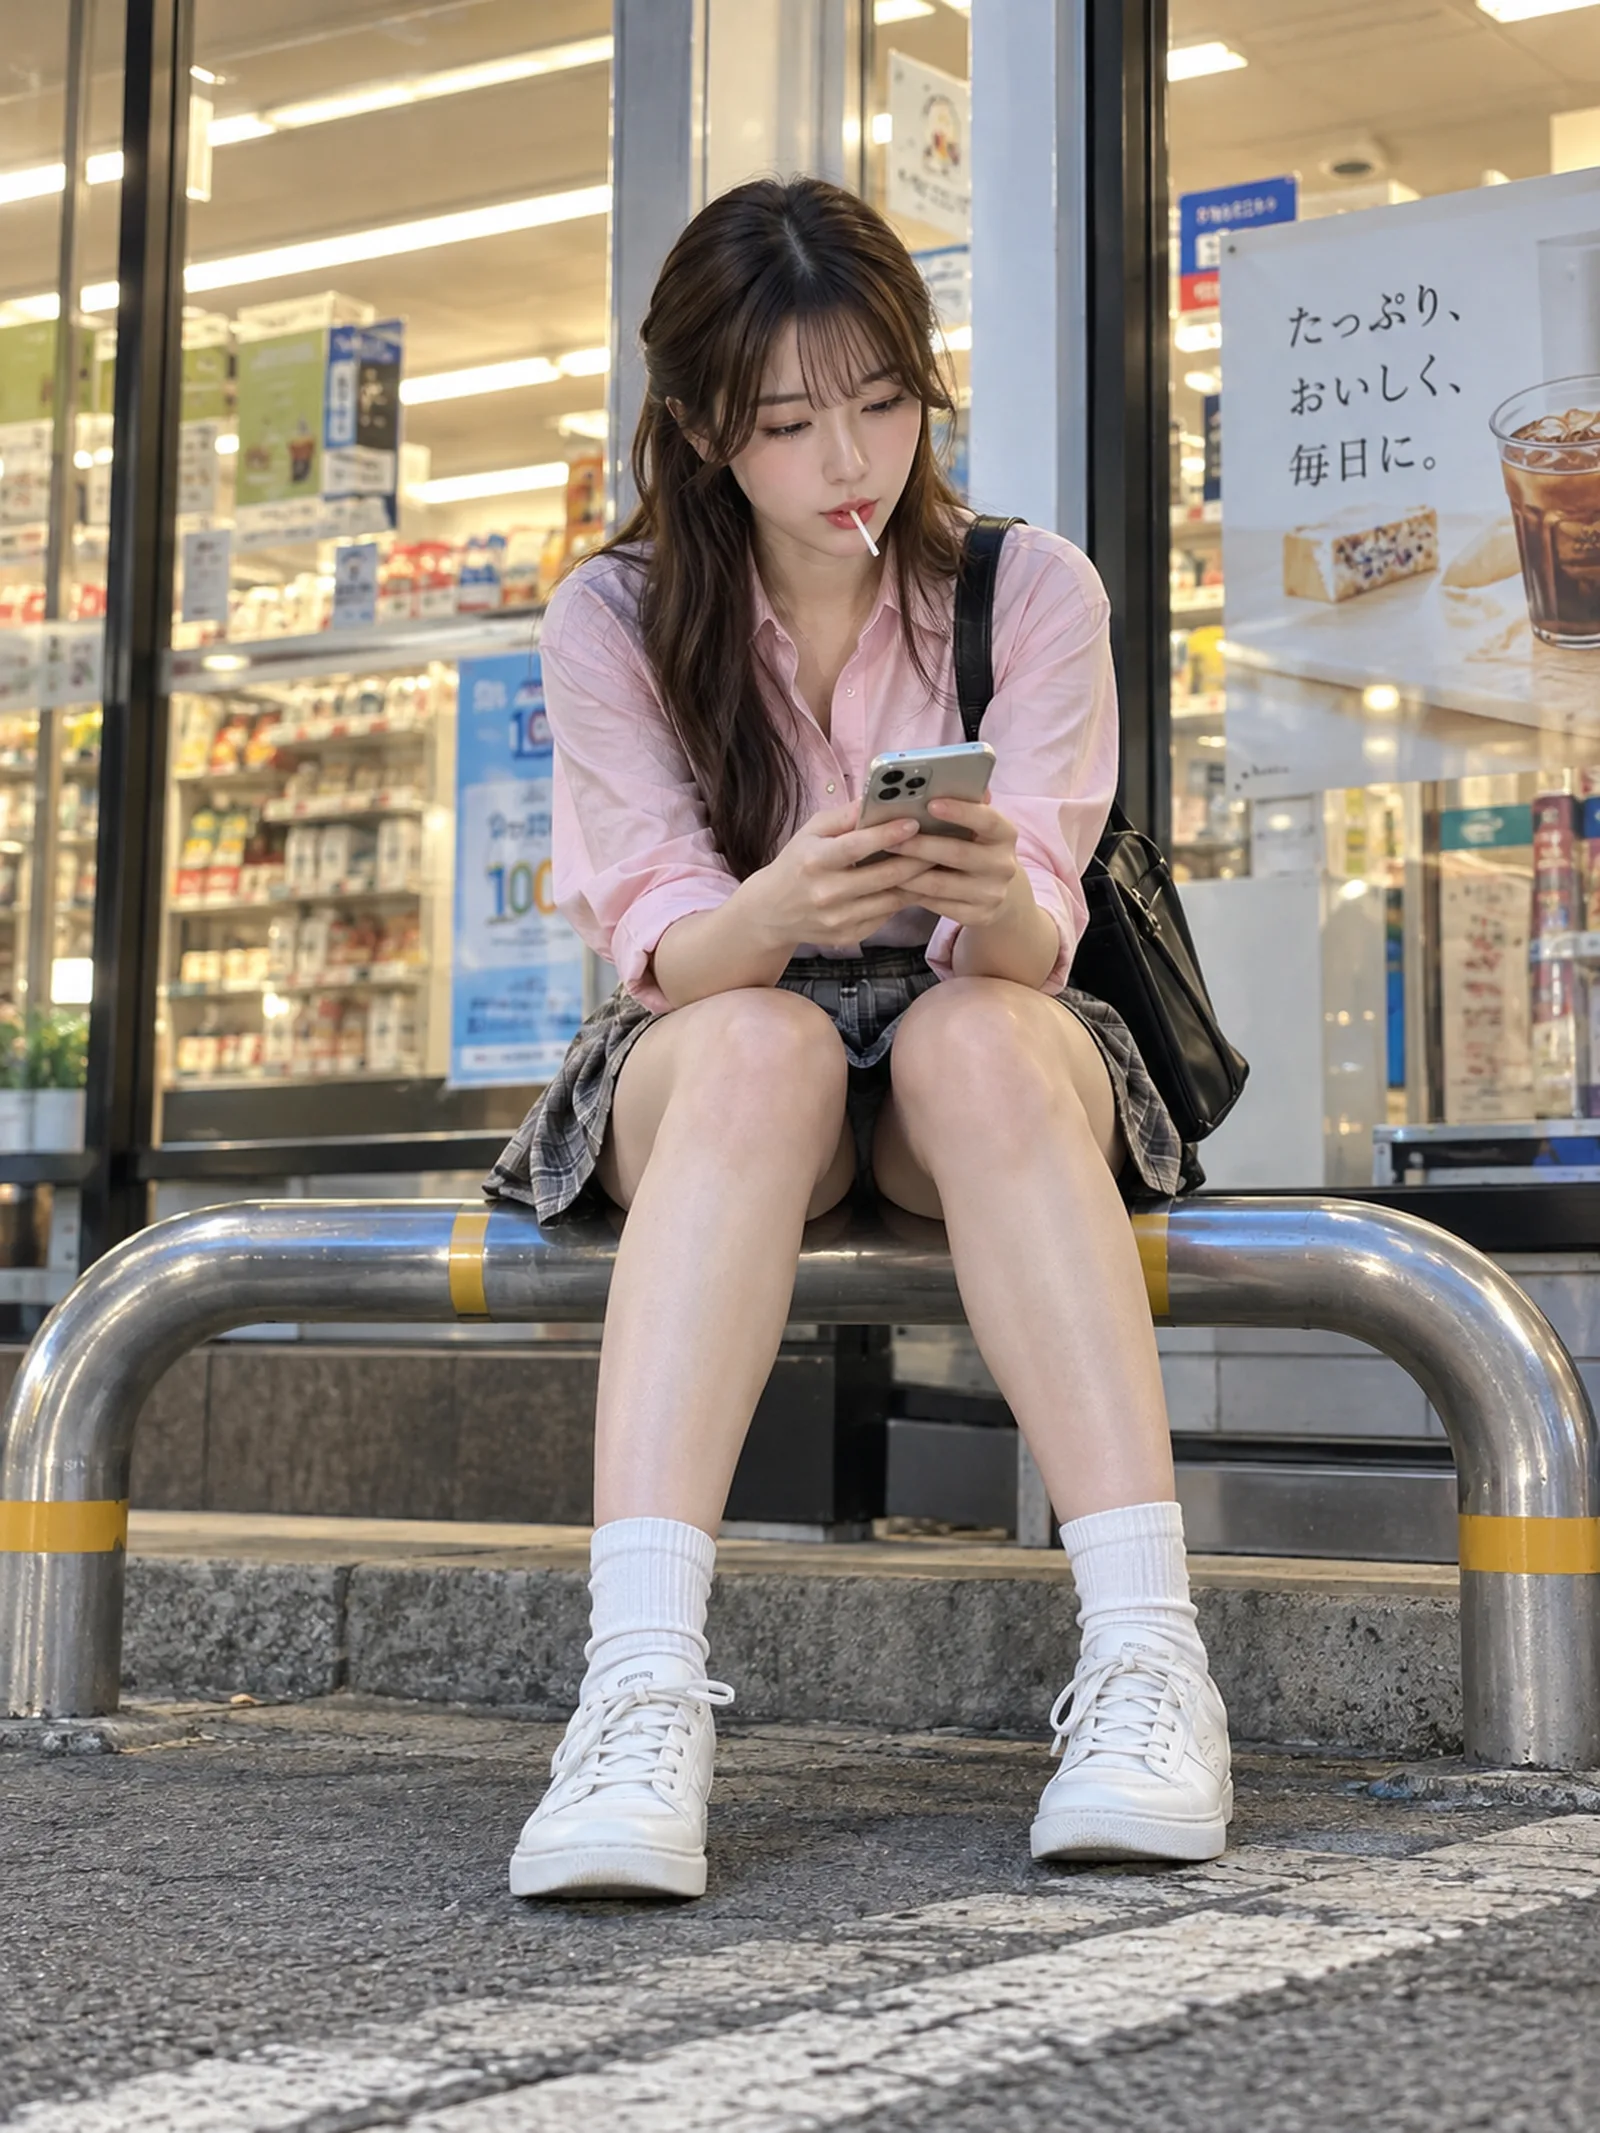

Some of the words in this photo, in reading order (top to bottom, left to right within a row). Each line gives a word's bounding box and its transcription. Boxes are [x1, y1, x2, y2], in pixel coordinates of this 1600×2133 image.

[1289, 284, 1461, 348] たっぷり、
[1290, 354, 1461, 416] おいしく、
[1288, 436, 1436, 488] 毎日に。
